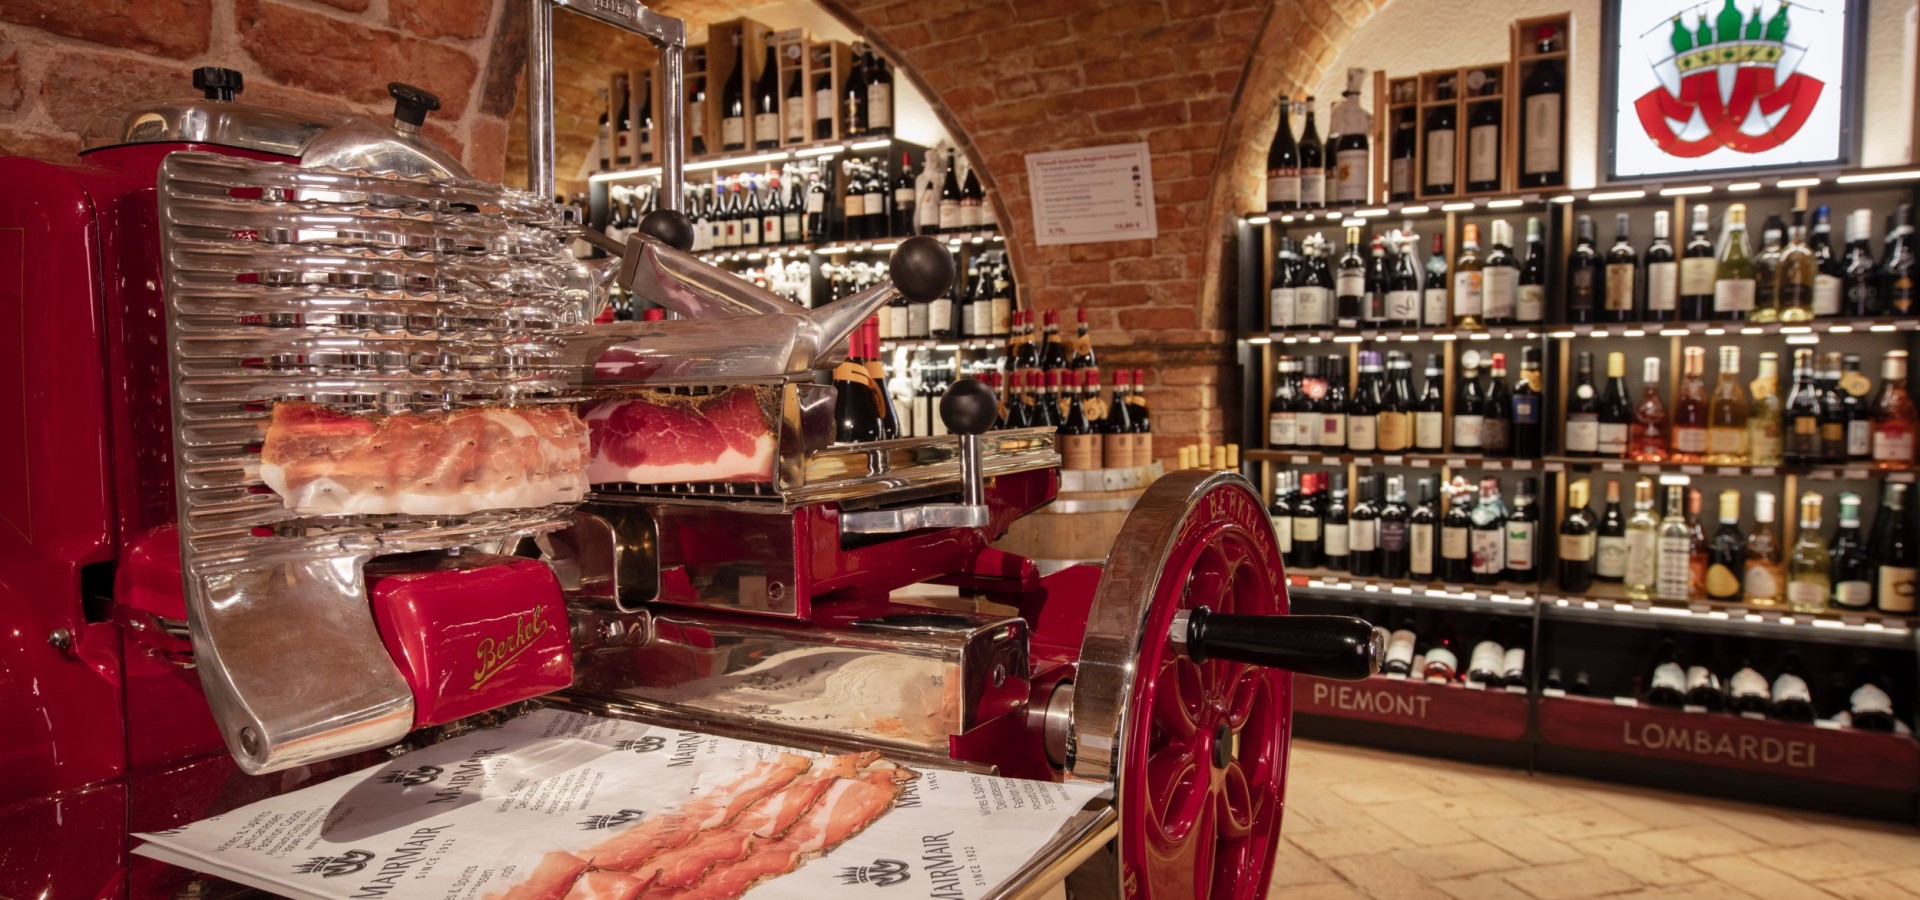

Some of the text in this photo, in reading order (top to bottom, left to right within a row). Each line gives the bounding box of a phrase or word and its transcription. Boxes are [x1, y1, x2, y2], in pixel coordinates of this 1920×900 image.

[470, 604, 548, 689] Berkel
[1314, 682, 1432, 718] PIEMONT
[1624, 720, 1816, 768] LOMBARDEI
[426, 745, 507, 804] MAIRMAIR
[926, 771, 939, 791] SINCE
[971, 776, 985, 795] Spirits
[979, 799, 993, 817] Wines
[349, 823, 455, 899] MAIRMAIR
[414, 838, 457, 880] SINCE 1922
[963, 845, 987, 887] SINCE 1922
